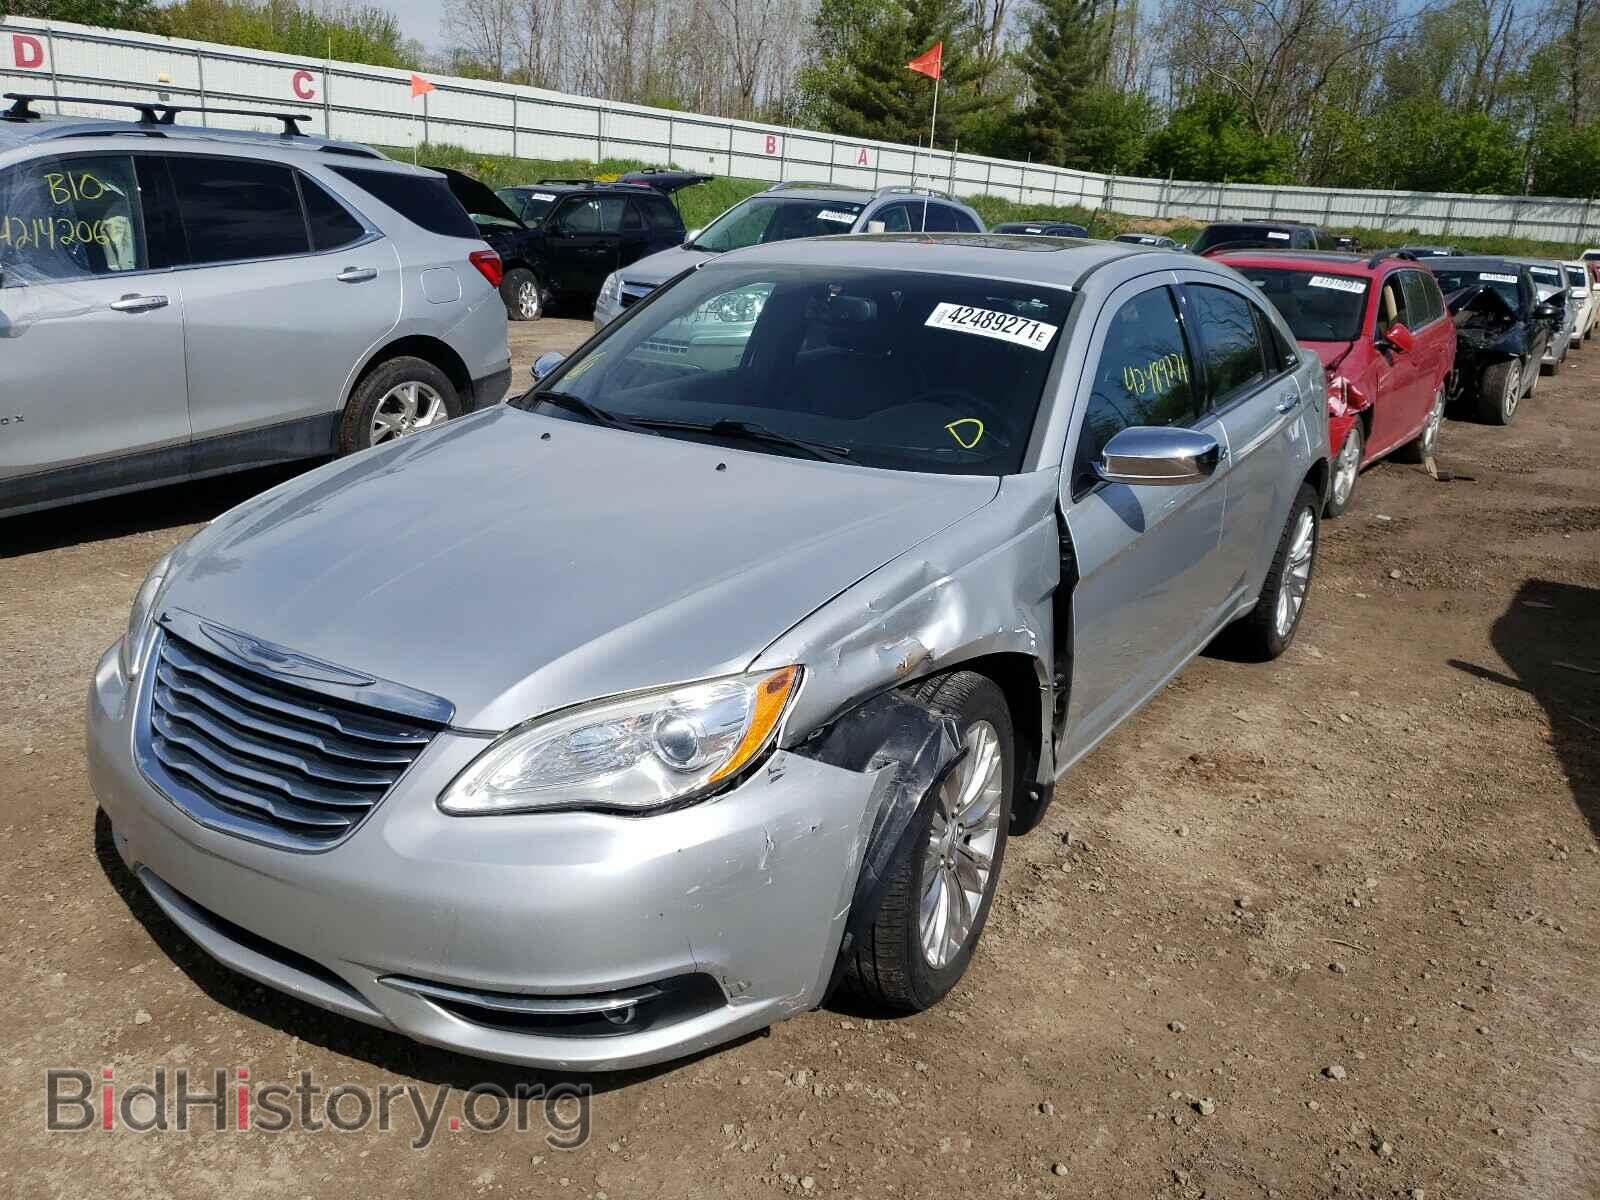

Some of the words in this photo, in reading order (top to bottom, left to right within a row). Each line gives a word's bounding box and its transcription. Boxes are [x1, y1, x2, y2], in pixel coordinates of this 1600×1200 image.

[12, 34, 45, 69] D
[292, 70, 316, 100] C
[766, 135, 776, 154] B
[858, 148, 868, 165] A
